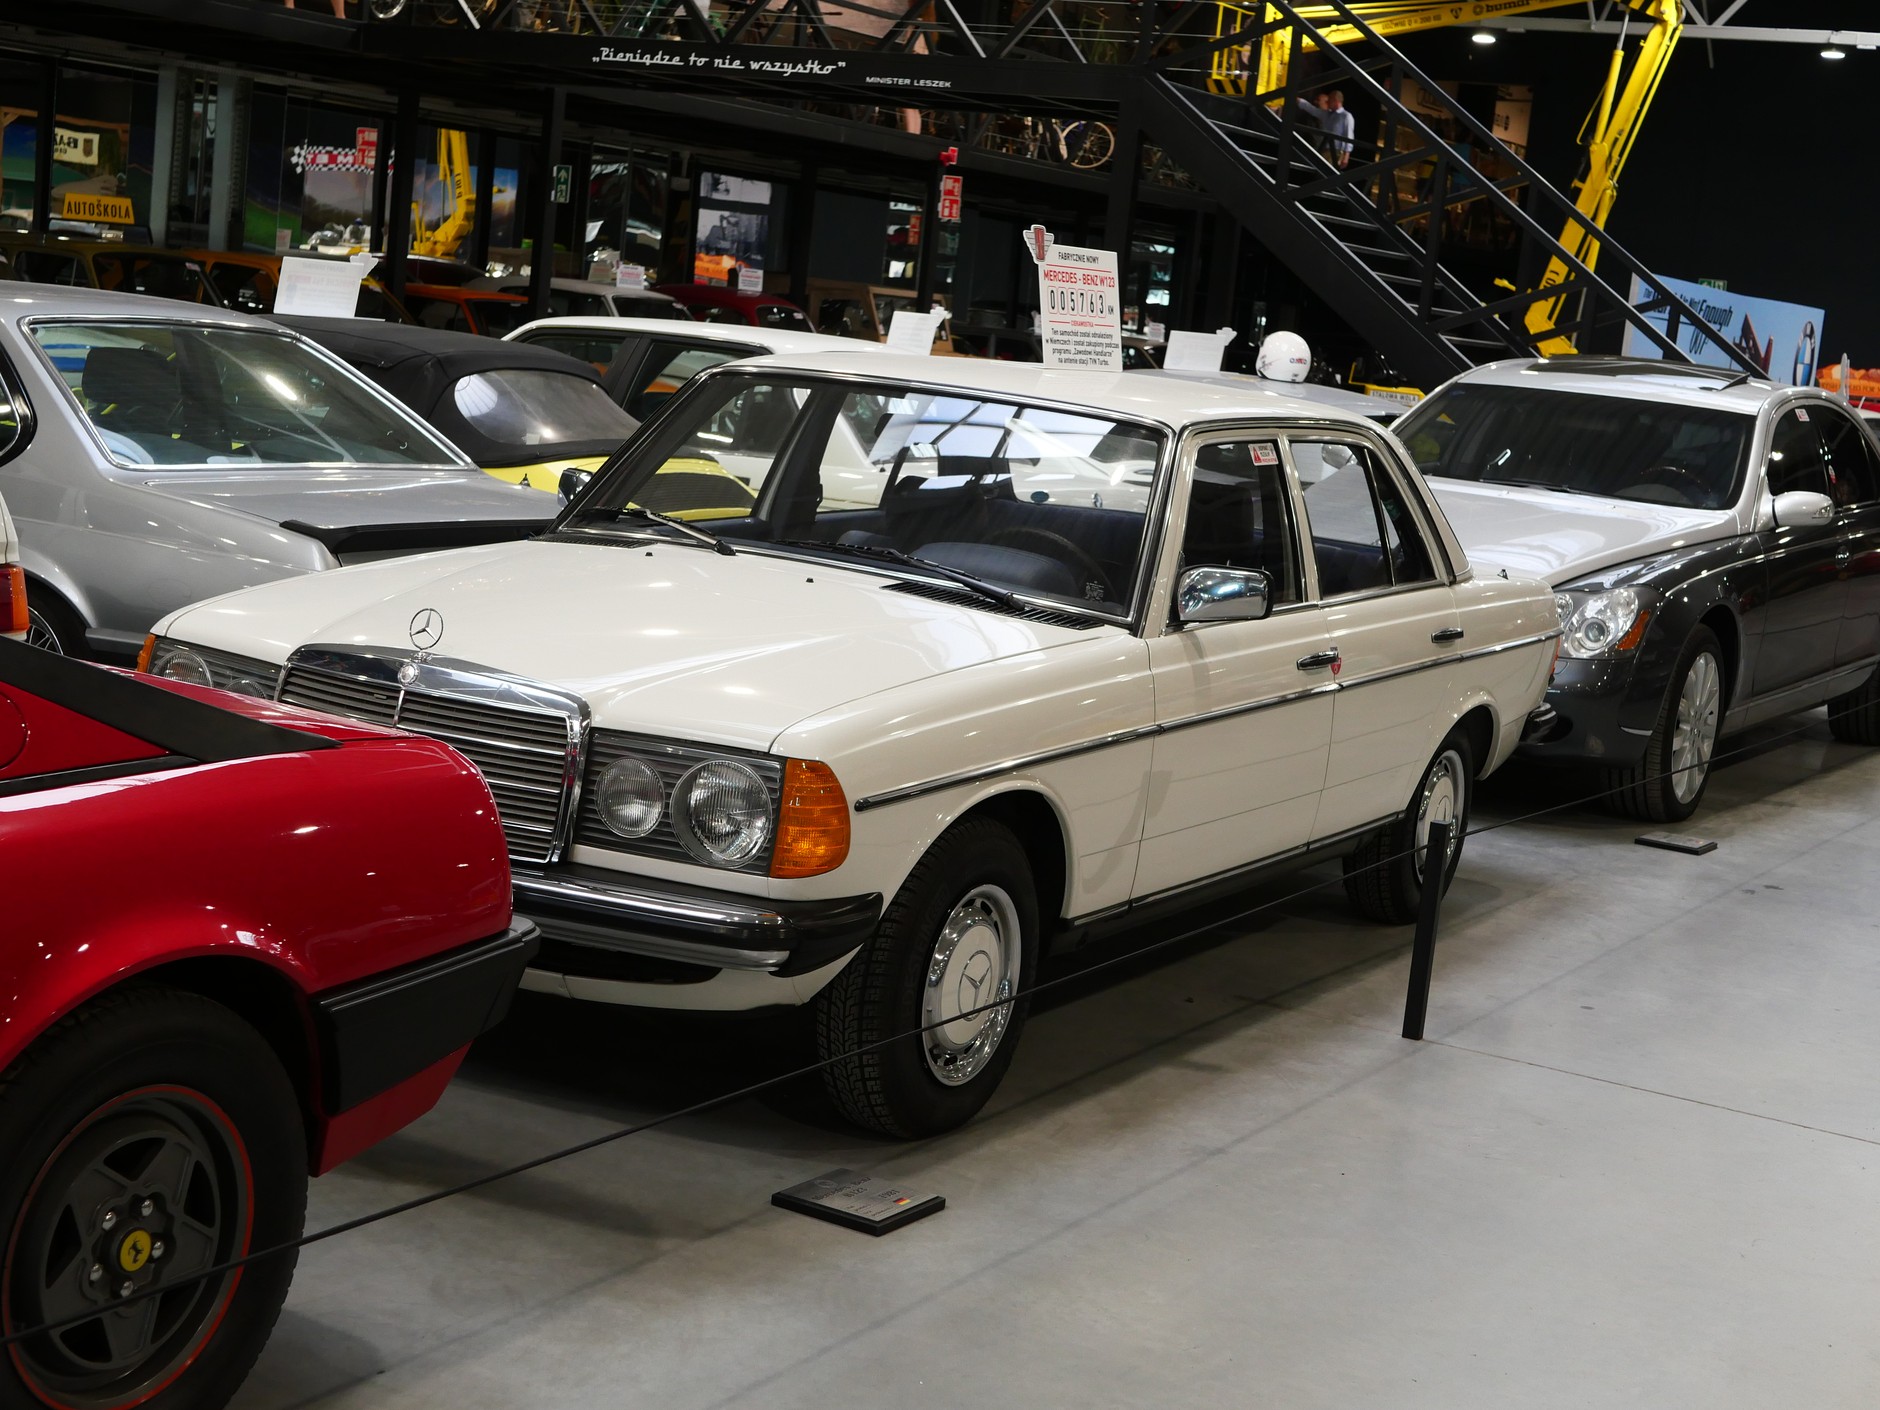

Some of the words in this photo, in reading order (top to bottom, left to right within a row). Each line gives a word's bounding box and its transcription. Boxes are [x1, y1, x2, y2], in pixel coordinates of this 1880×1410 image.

[688, 52, 710, 67] to
[713, 55, 746, 69] nie
[865, 76, 911, 86] MINISTER
[913, 79, 952, 88] LESZEK
[66, 198, 131, 219] AUTOŠKOLA
[1058, 251, 1086, 263] FABRYCZNIE
[1086, 254, 1099, 265] NOWY
[1043, 269, 1077, 284] MERCEDES
[1082, 273, 1099, 286] BENZ
[1099, 275, 1115, 288] W123
[1049, 289, 1104, 315] 005763
[1698, 299, 1734, 332] Enough
[1051, 328, 1059, 336] Ten
[1060, 329, 1079, 337] samochód
[1049, 338, 1071, 346] Niemczech
[1052, 348, 1071, 356] programu
[1089, 358, 1097, 366] TVN
